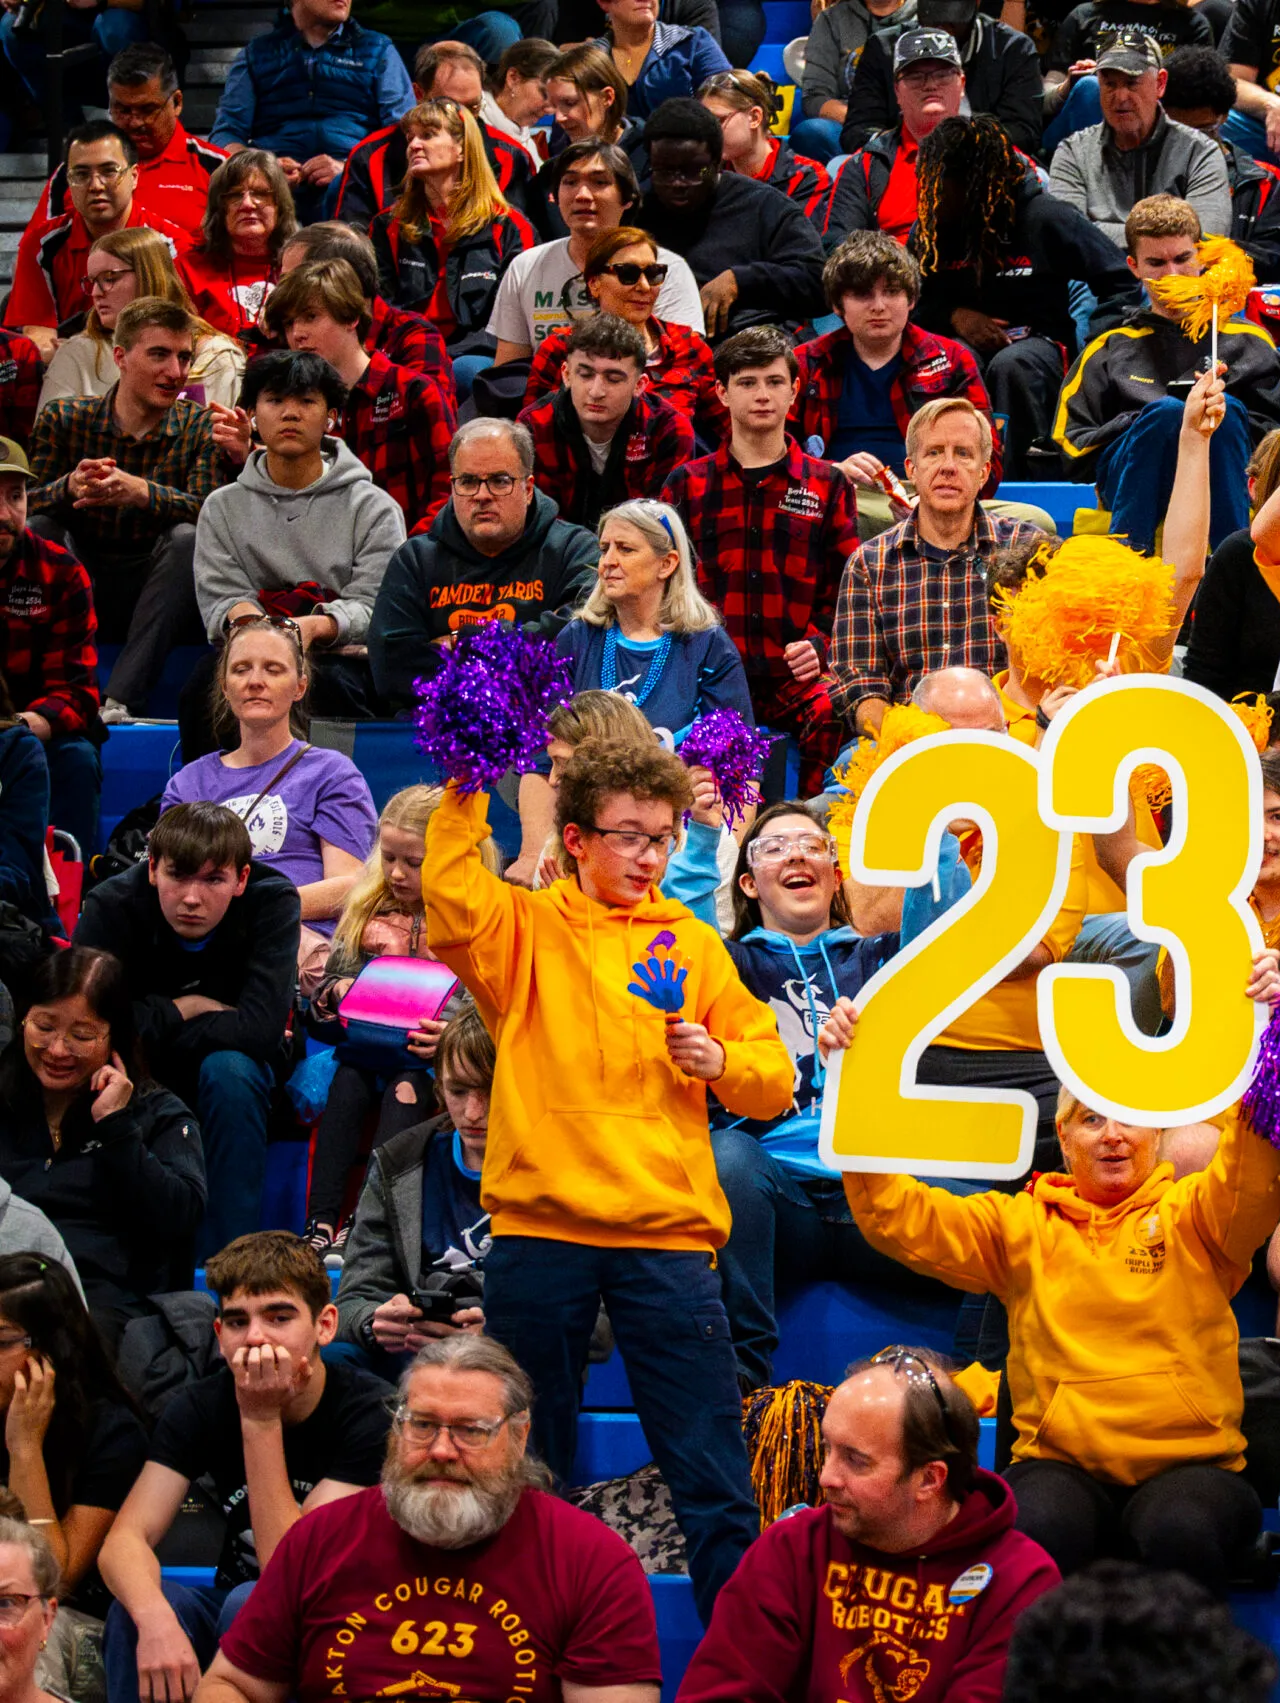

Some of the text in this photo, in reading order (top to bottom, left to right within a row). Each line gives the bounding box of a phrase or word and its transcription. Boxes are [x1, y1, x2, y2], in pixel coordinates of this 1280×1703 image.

[1100, 21, 1162, 35] RAGNARO
[996, 267, 1033, 277] 472
[429, 579, 545, 609] CAMDEN YARDS
[374, 1576, 484, 1613] COUGAR
[823, 1560, 965, 1617] CUGA
[391, 1619, 479, 1659] 623
[832, 1599, 950, 1642] ROBOTS
